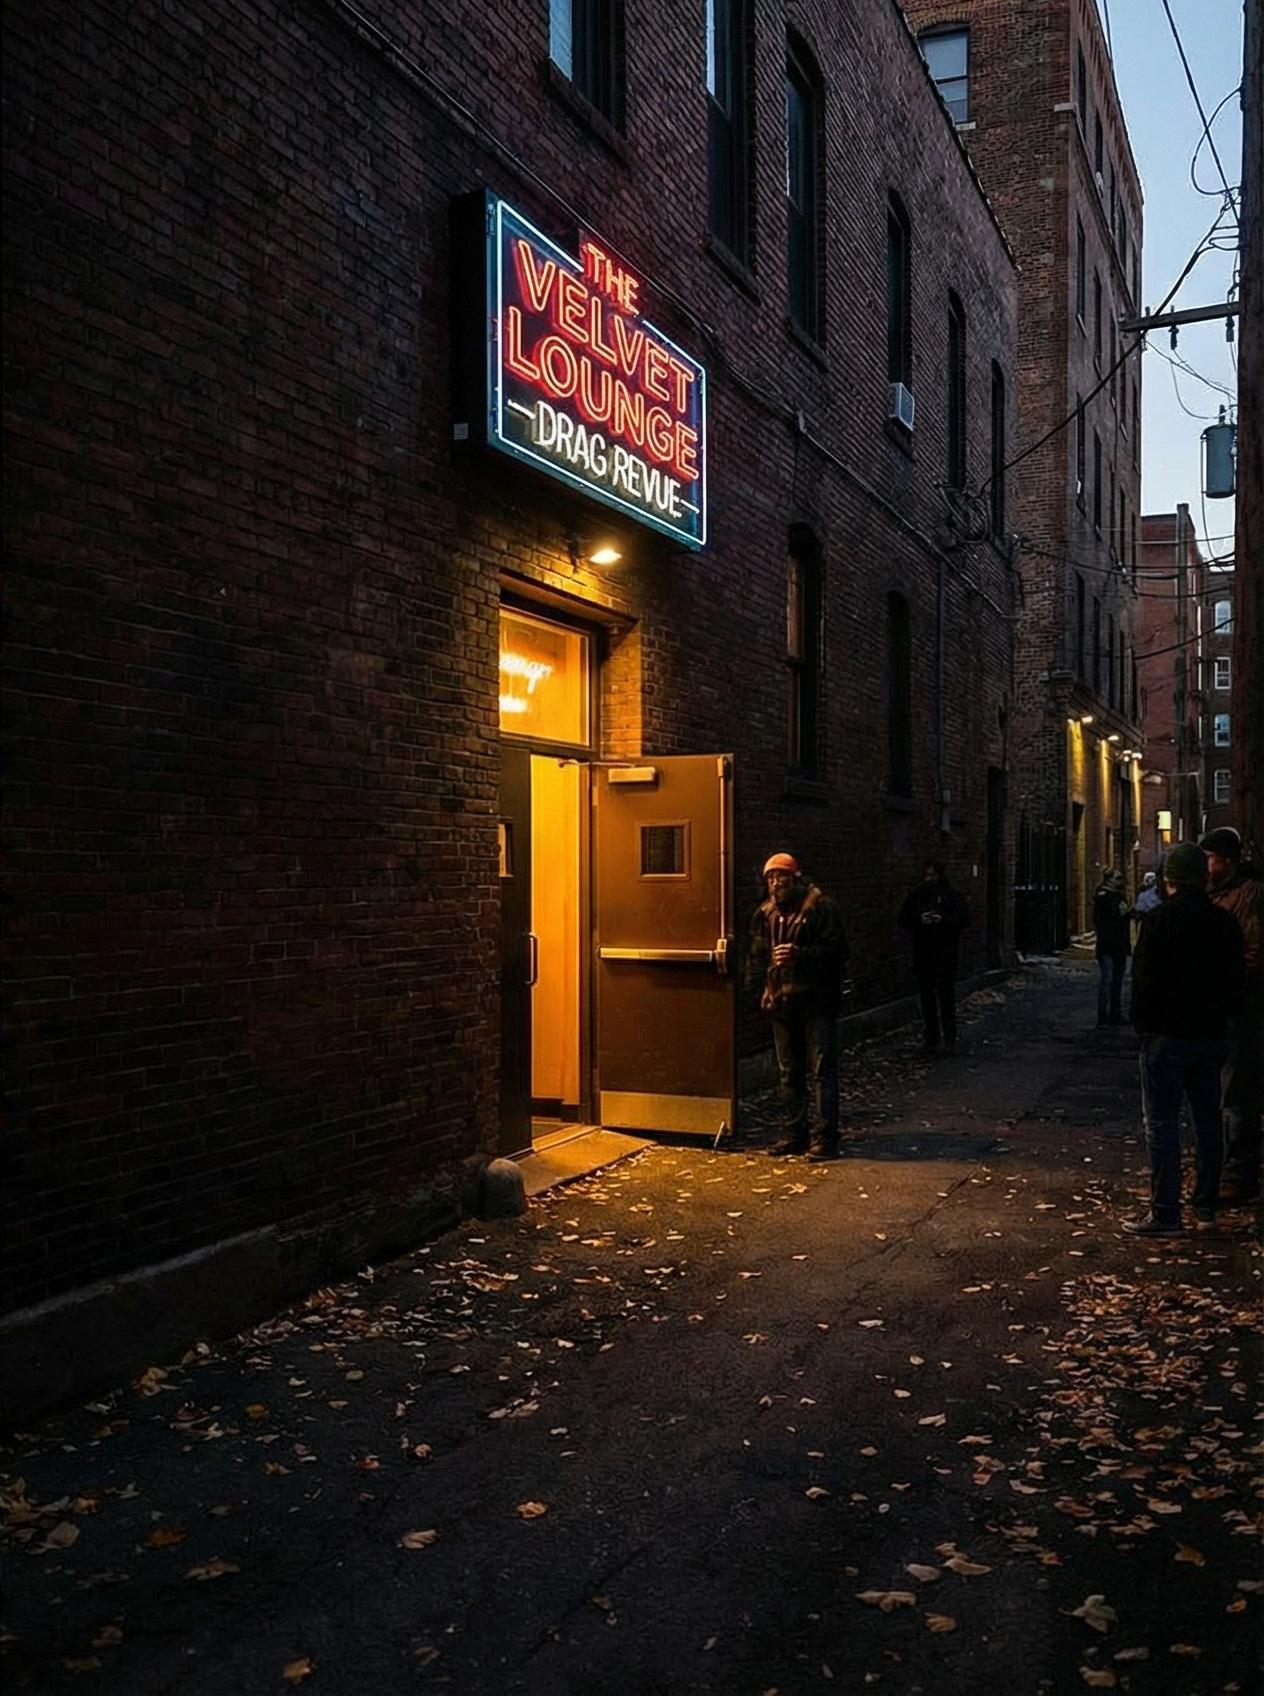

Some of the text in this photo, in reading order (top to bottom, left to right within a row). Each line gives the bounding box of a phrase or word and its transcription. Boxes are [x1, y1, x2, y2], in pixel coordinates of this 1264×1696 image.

[516, 239, 695, 414] VELVET
[583, 242, 640, 316] THE
[508, 305, 700, 480] LOUNGE
[534, 400, 683, 518] DRAG REVUE
